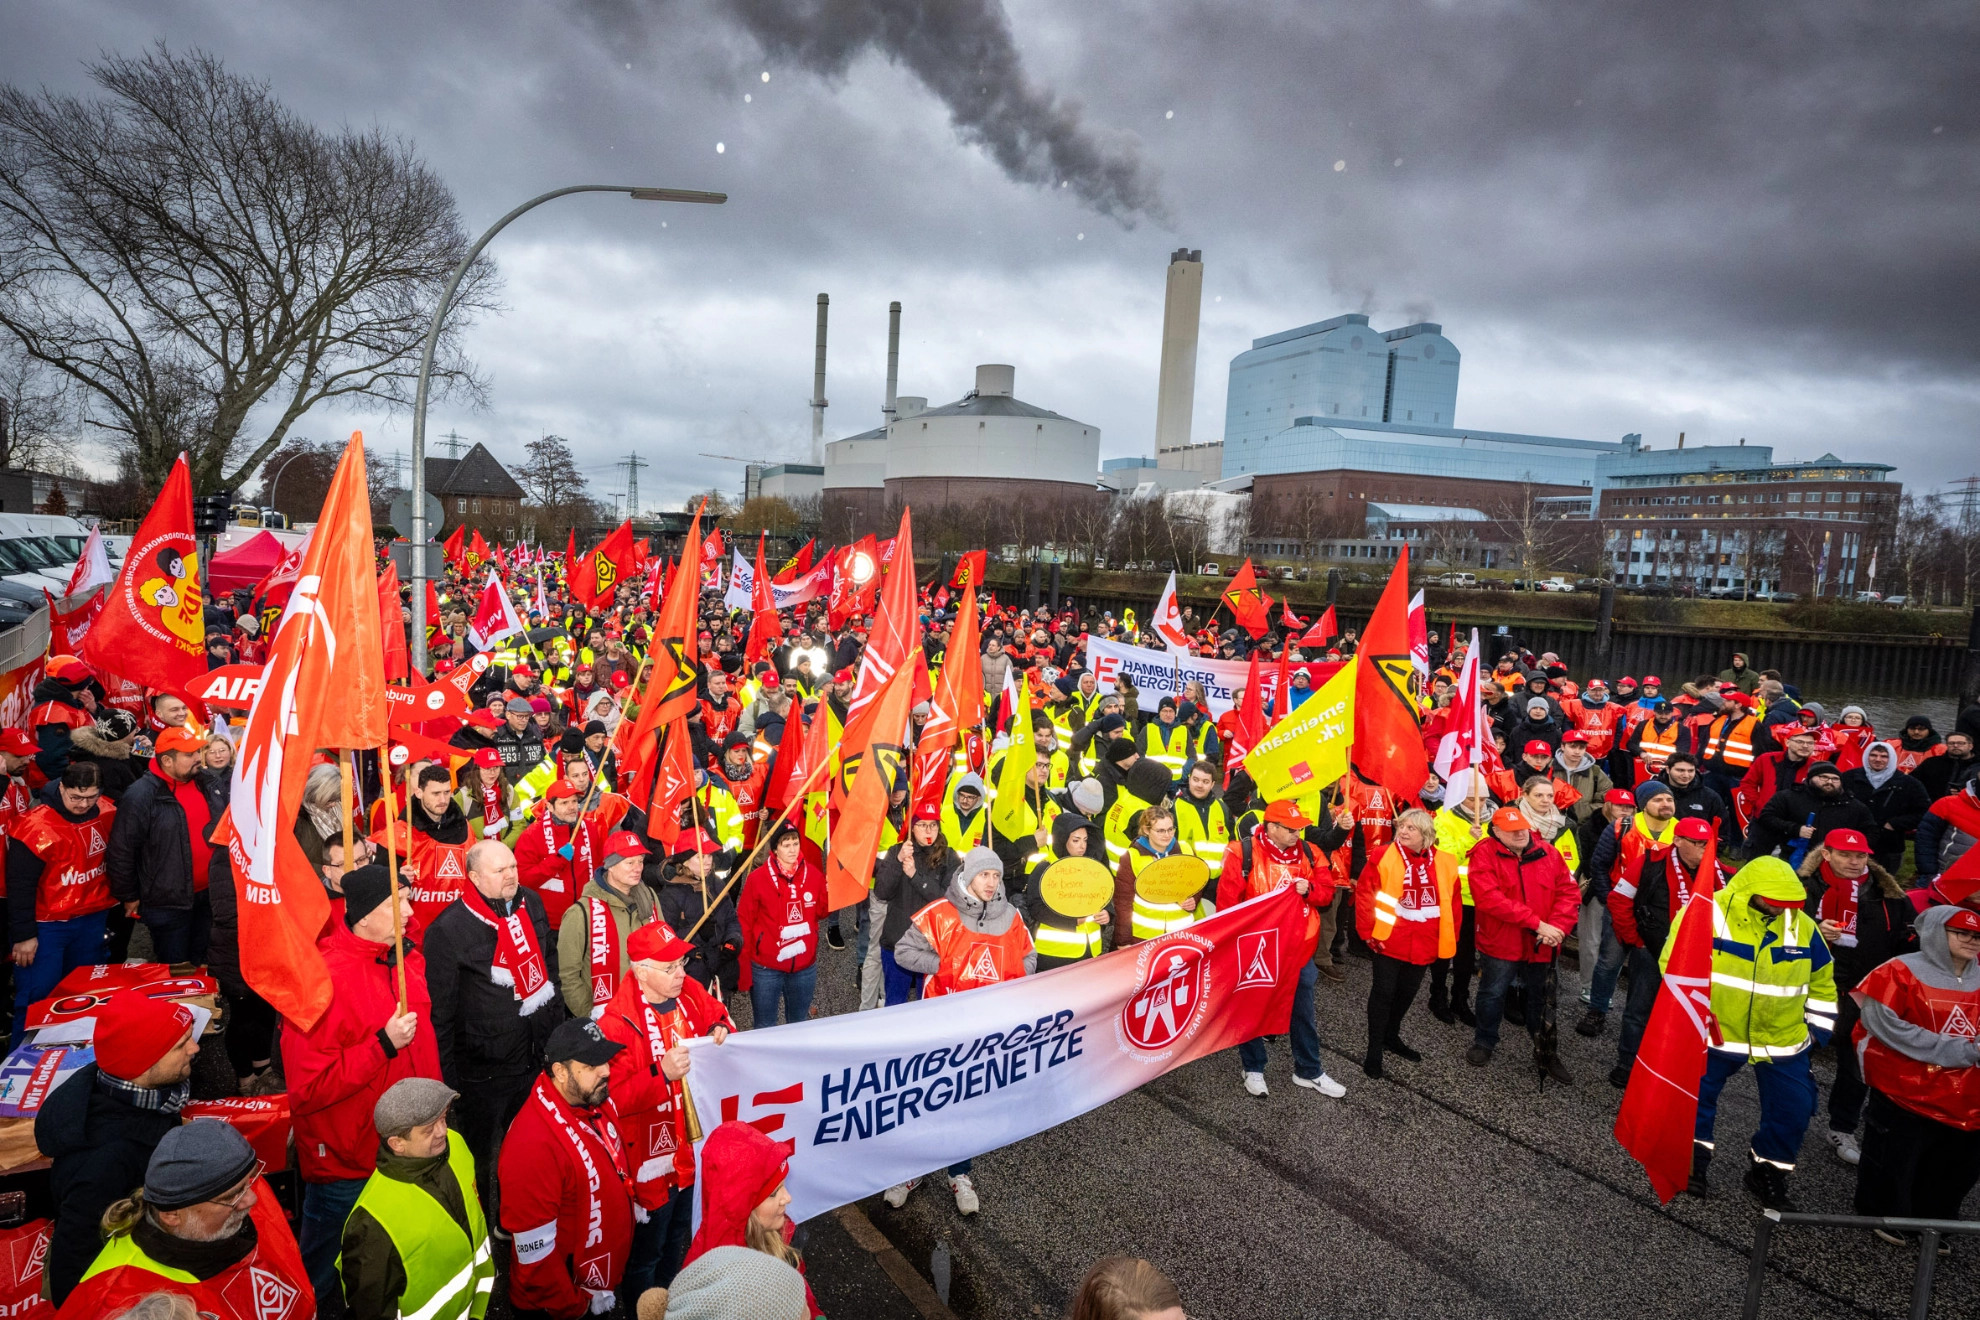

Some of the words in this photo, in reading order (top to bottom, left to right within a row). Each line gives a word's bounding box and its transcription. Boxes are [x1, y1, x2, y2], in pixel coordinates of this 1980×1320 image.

[1122, 660, 1216, 685] HAMBURGER
[1131, 967, 1145, 997] OLLE
[1203, 959, 1212, 999] METALL
[1200, 1001, 1208, 1013] IG
[1184, 1013, 1203, 1040] TEAM
[821, 1009, 1074, 1113] HAMBURGER
[23, 1077, 46, 1109] Wir
[813, 1025, 1087, 1147] ENERGIENETZE
[516, 1239, 545, 1254] ORDNER
